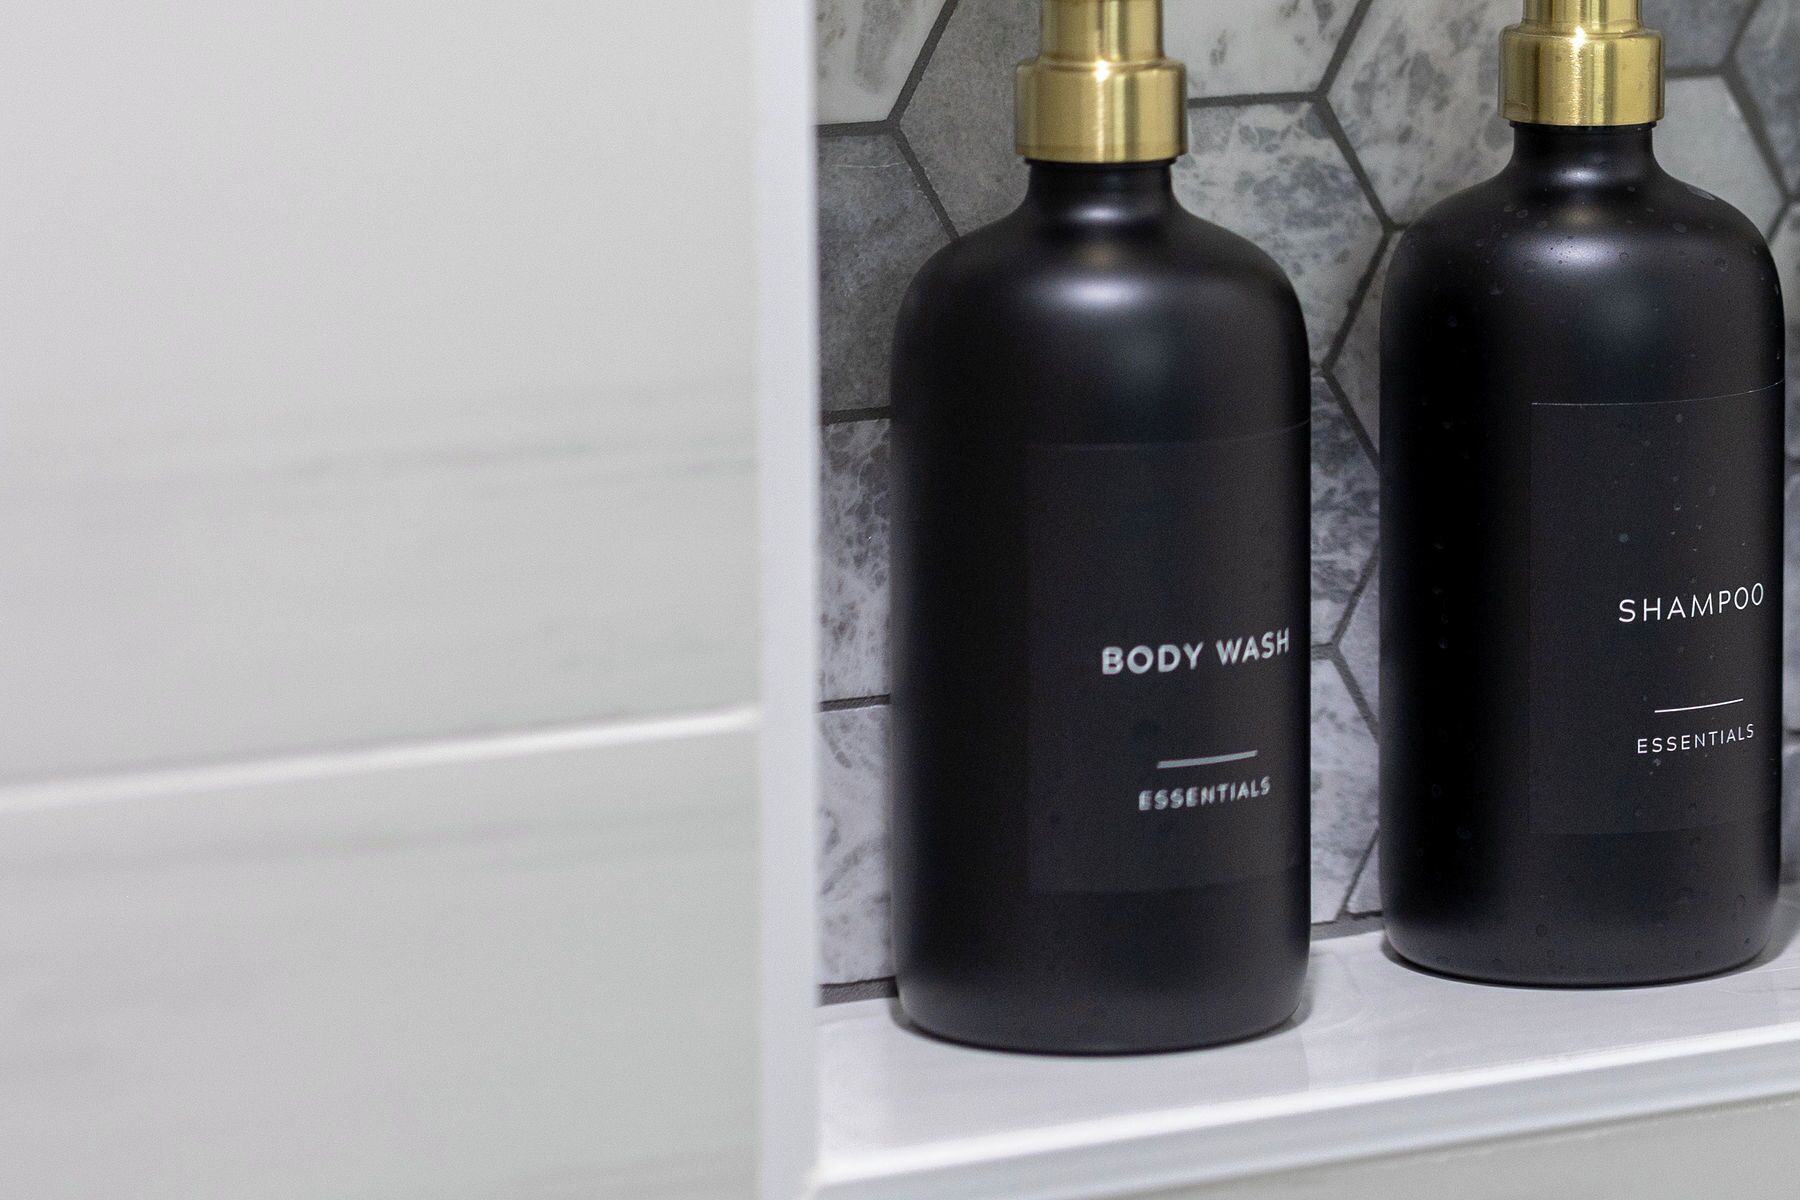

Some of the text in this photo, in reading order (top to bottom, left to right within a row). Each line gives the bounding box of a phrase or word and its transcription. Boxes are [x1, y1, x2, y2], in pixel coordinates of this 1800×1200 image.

[1618, 582, 1765, 624] SHAMPOO
[1101, 627, 1291, 676] BODY WASH
[1637, 723, 1756, 755] ESSENTIALS
[1138, 776, 1272, 812] ESSENTIALS
